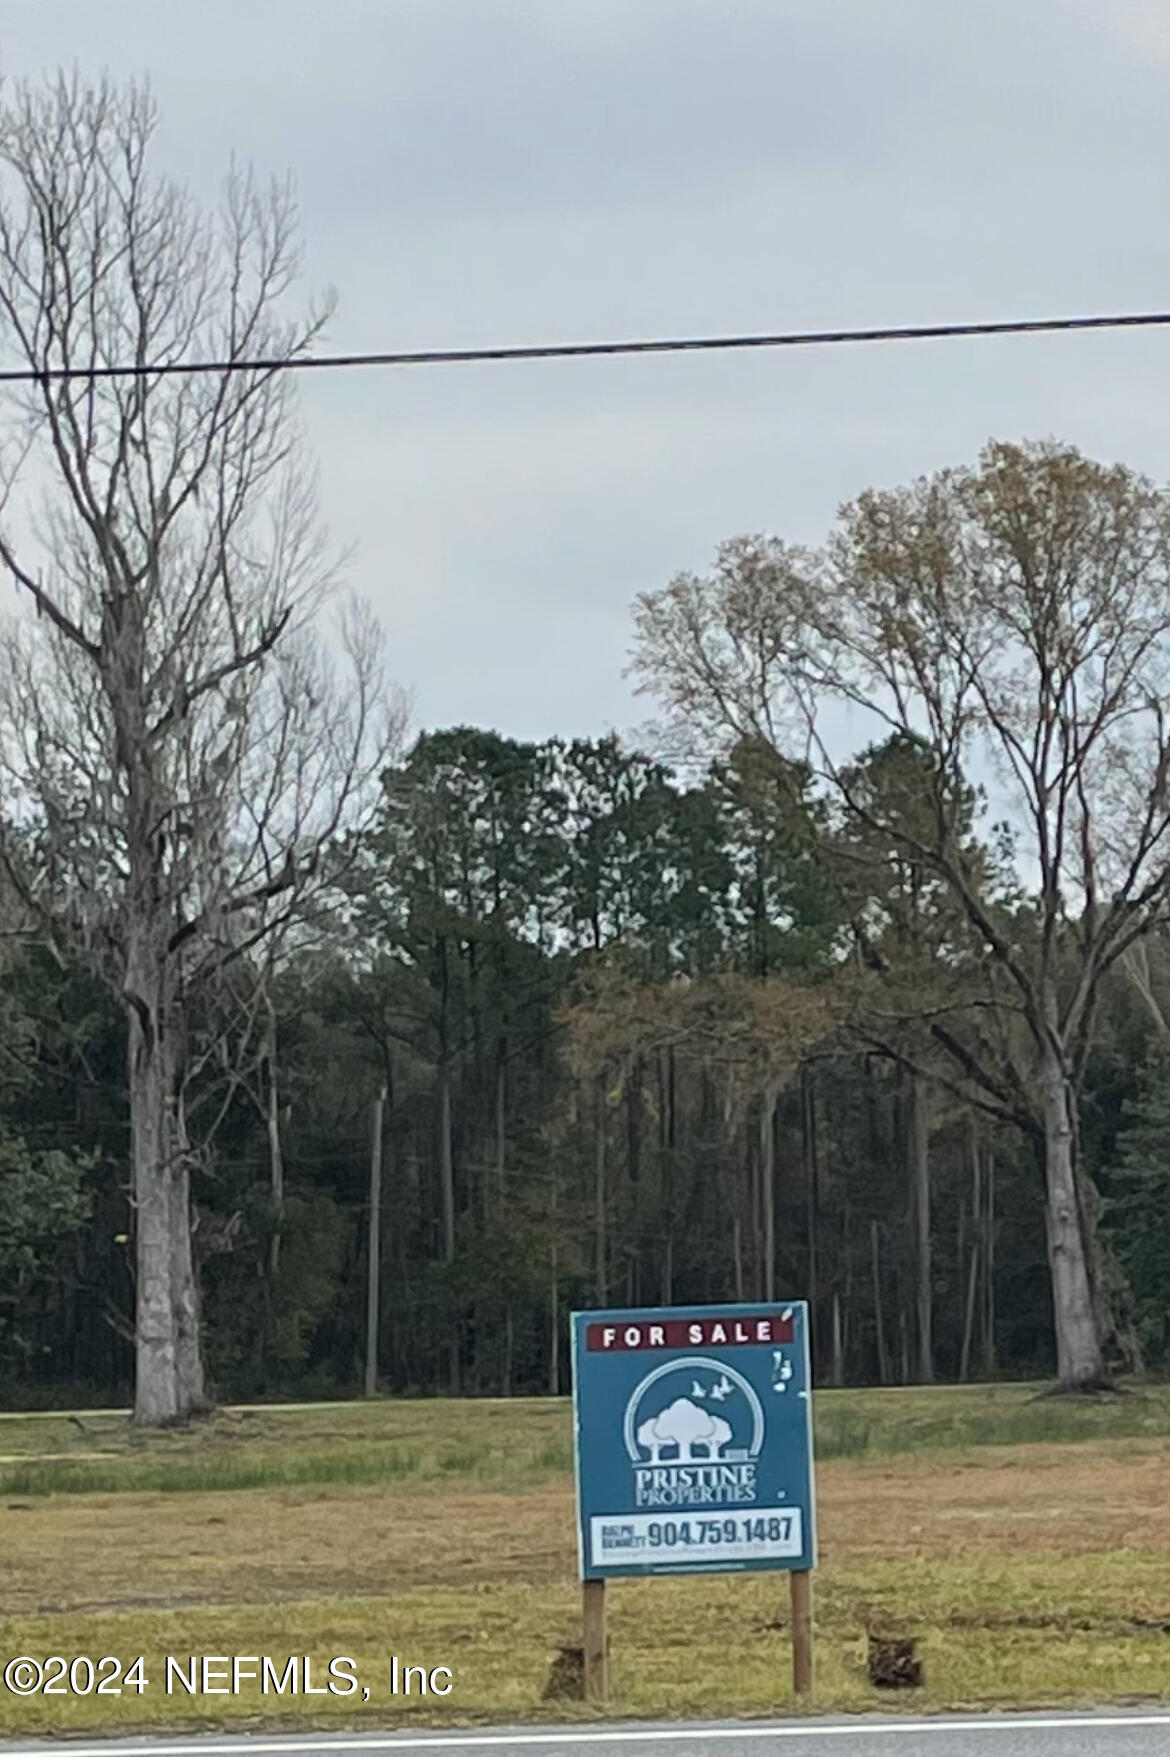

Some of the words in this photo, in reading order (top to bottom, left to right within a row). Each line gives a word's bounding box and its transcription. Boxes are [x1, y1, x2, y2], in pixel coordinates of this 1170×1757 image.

[603, 1326, 665, 1347] FOR
[689, 1321, 771, 1343] SALE
[635, 1464, 756, 1488] PRISTINE
[635, 1482, 756, 1507] PROPERTIES
[648, 1516, 793, 1547] 904.759.1487
